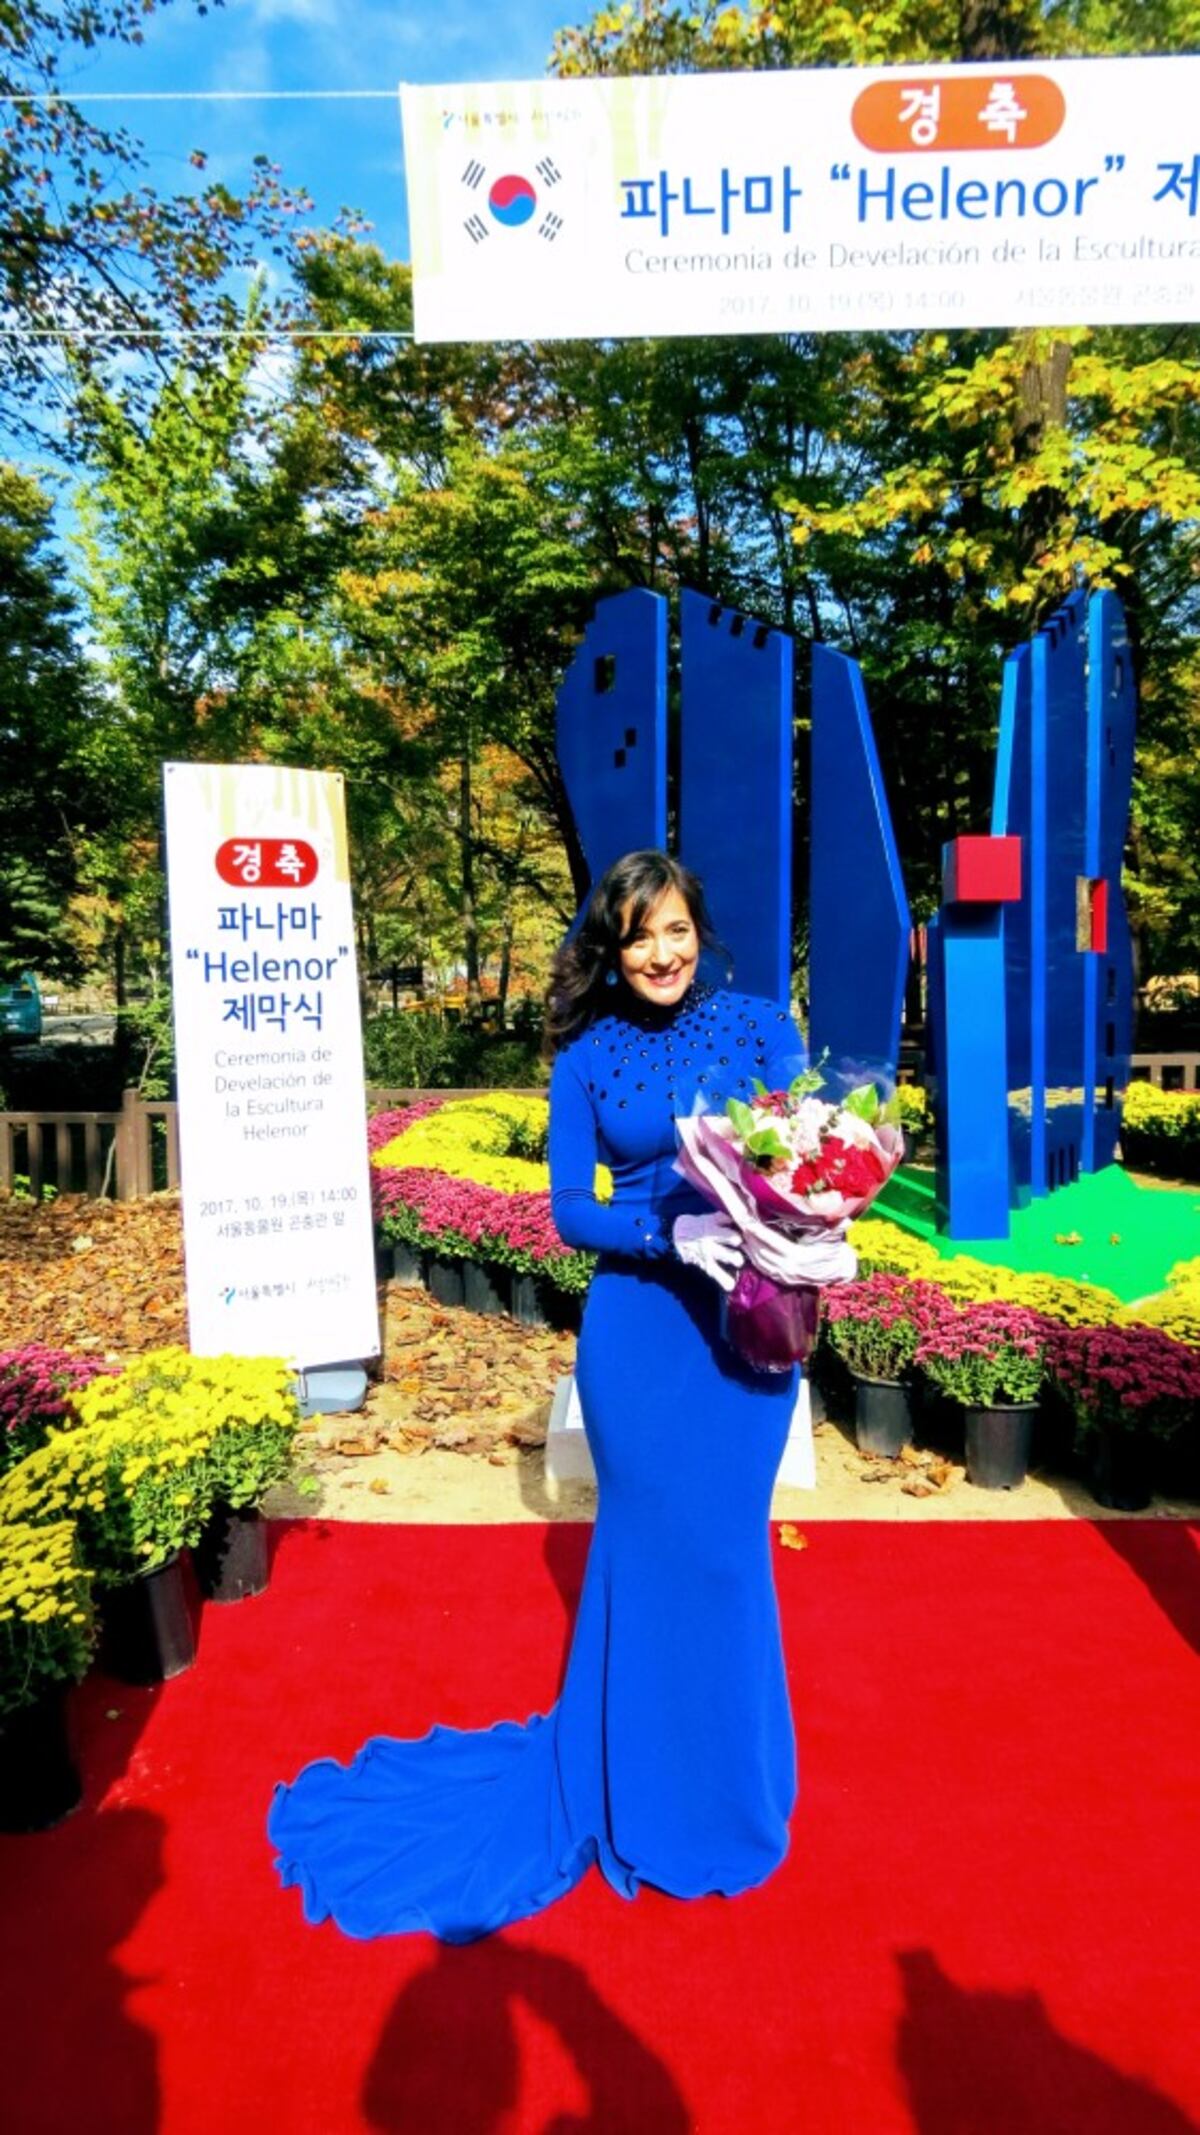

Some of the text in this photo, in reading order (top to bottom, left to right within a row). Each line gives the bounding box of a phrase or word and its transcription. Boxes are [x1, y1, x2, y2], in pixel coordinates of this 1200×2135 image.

[620, 166, 802, 237] 파나마
[624, 234, 1200, 274] Ceremonia de Develación de la Escultura
[217, 902, 322, 941] 파나마
[222, 990, 323, 1032] 제막식
[214, 1046, 332, 1068] Ceremonia de
[215, 1071, 332, 1093] Develación de
[225, 1097, 324, 1118] la Escultura
[243, 1122, 309, 1141] Helenor
[321, 1186, 357, 1203] 14:00
[216, 1216, 284, 1239] 서울동물원
